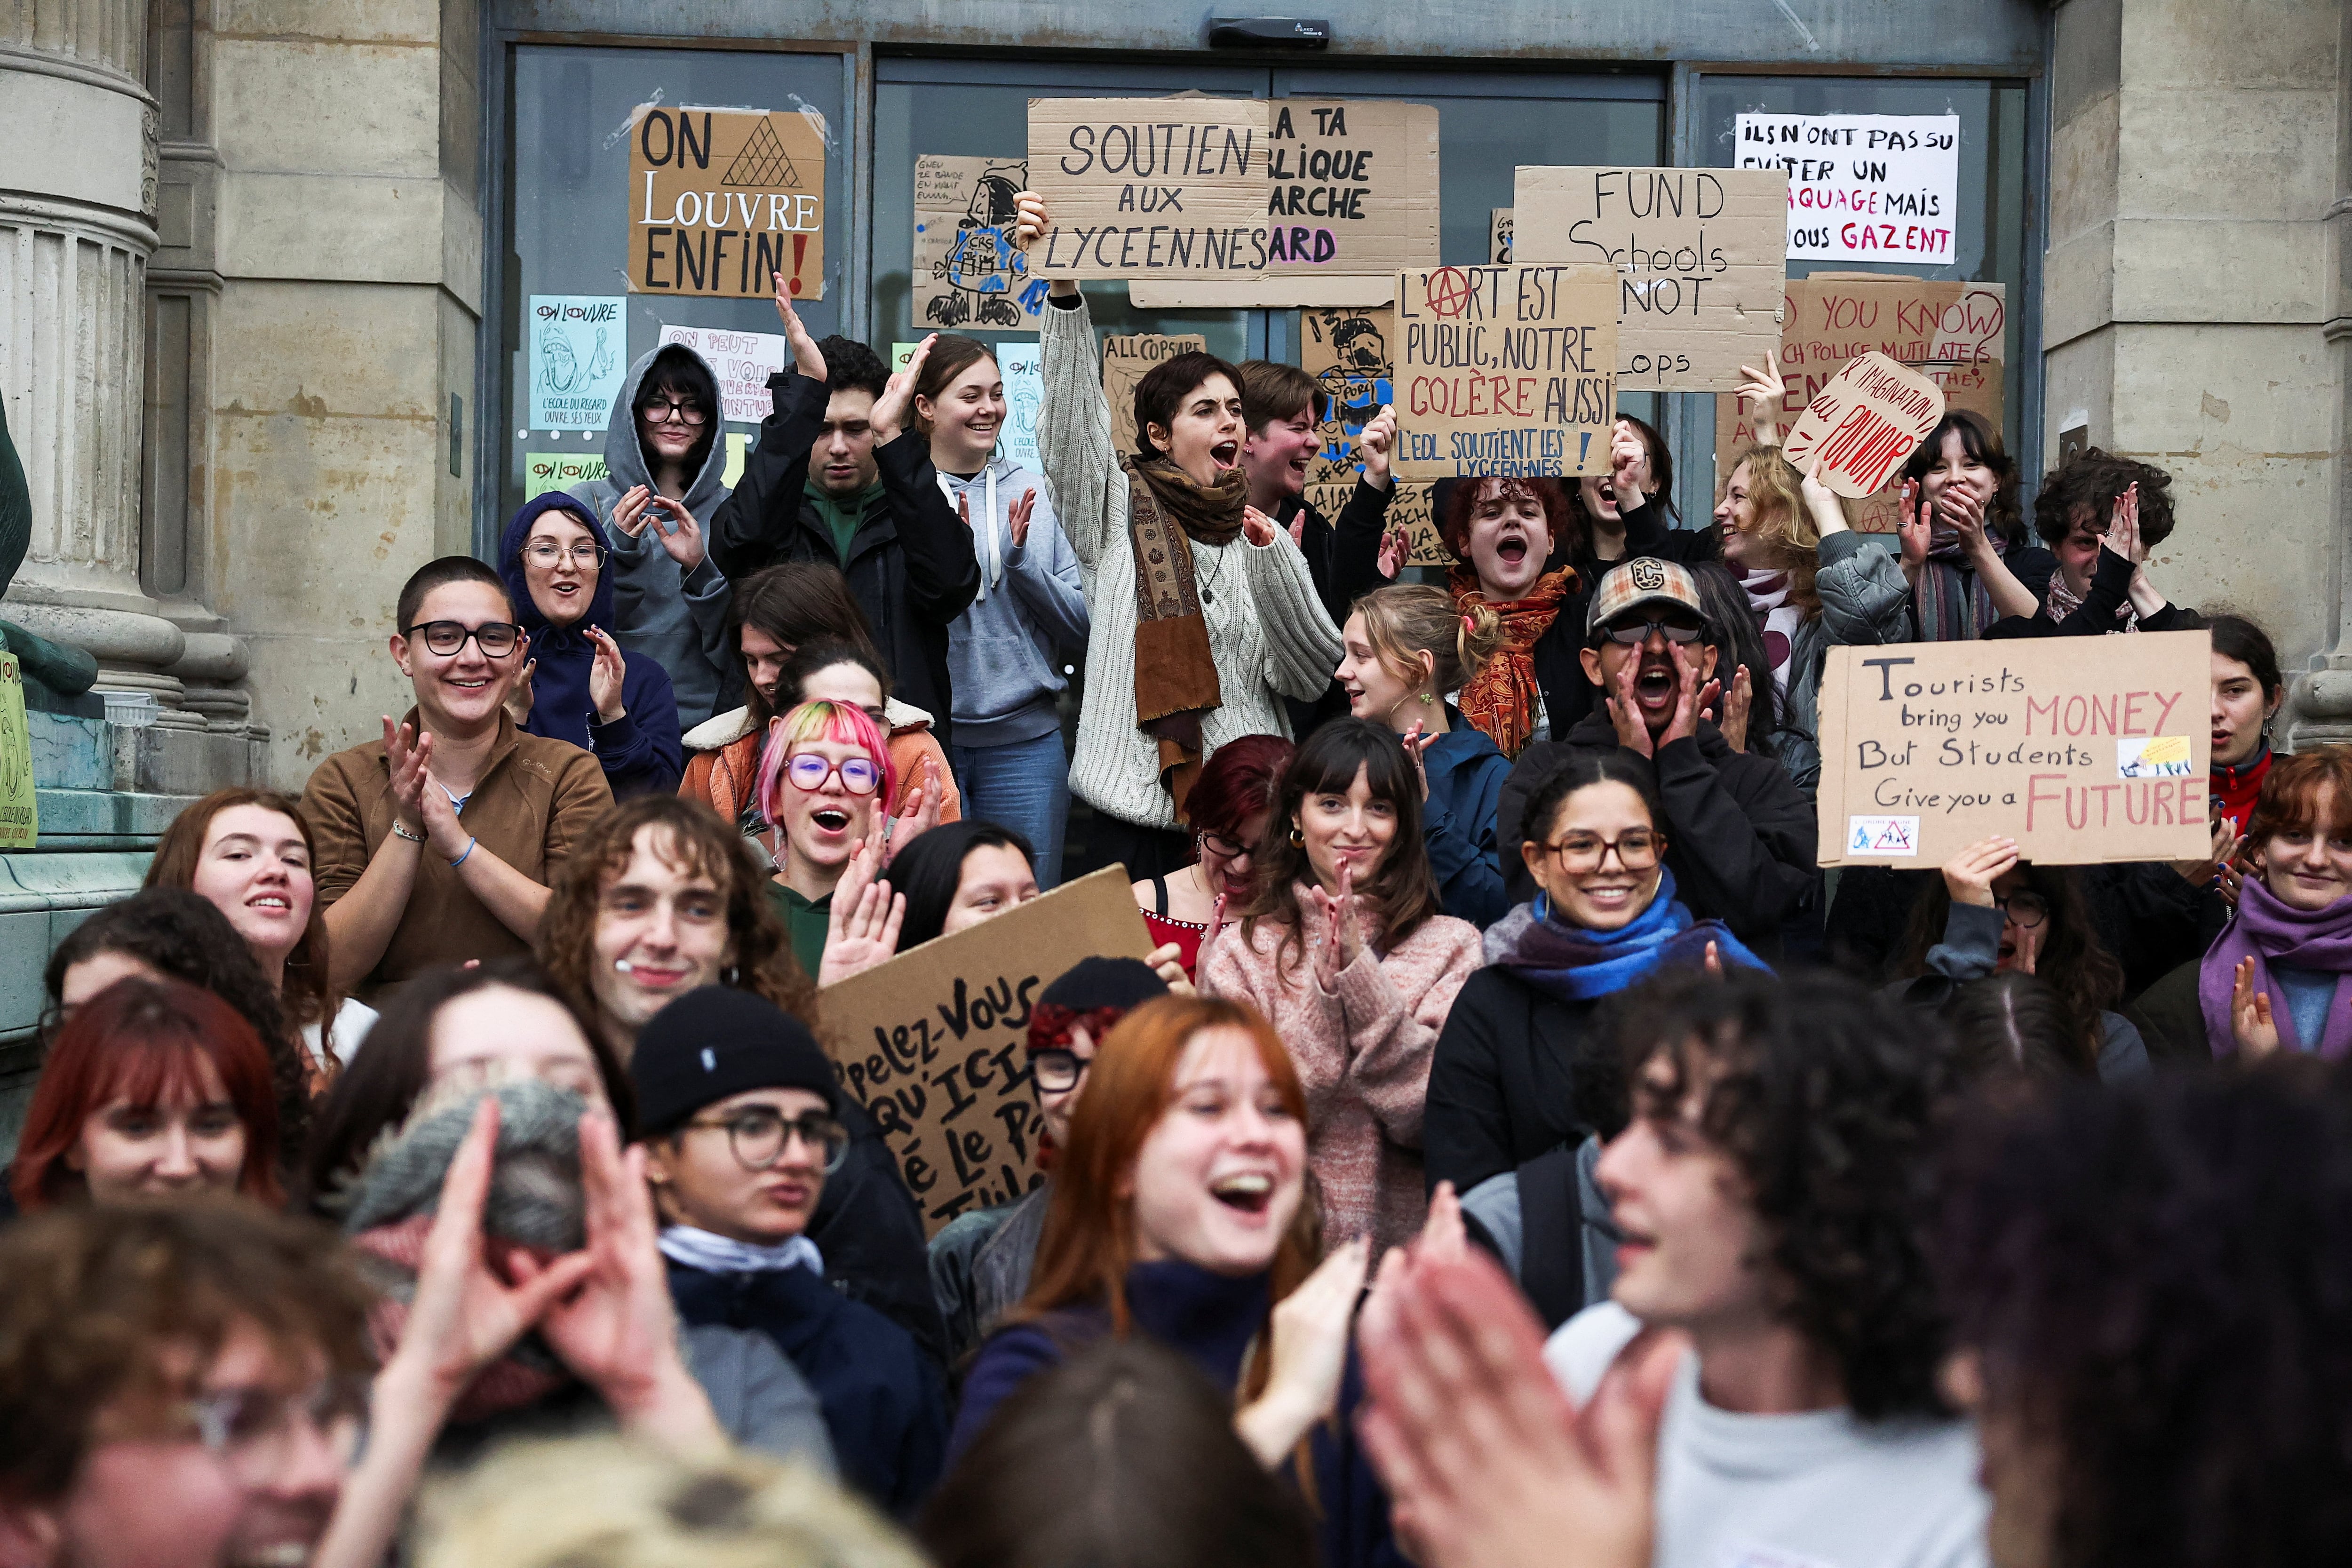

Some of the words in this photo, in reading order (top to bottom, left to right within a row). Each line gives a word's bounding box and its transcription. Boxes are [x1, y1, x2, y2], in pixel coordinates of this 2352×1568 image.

[1311, 107, 1347, 136] TA
[1781, 119, 1858, 145] N'ONT
[1867, 130, 1919, 151] PAS
[1924, 132, 1954, 150] SU
[642, 110, 710, 169] ON
[1061, 124, 1252, 176] SOUTIEN
[1853, 161, 1886, 183] UN
[637, 170, 819, 231] LOUVRE
[1118, 184, 1183, 213] AUX
[1595, 171, 1724, 219] FUND
[969, 236, 994, 249] CRS
[1788, 227, 1829, 247] OUS
[1841, 223, 1951, 253] GAZENT
[1401, 266, 1509, 321] L'ART
[1517, 266, 1568, 321] EST
[1623, 277, 1713, 316] NOT
[537, 303, 560, 321] ON
[562, 303, 618, 323] LOUVRE
[1822, 295, 1878, 331] YOU
[669, 330, 698, 347] ON
[707, 333, 758, 354] PEUT
[1105, 338, 1138, 358] ALL
[1140, 339, 1176, 360] COPS
[1503, 326, 1596, 373] NOTRE
[1617, 355, 1690, 384] ops
[1930, 371, 1985, 389] THEY
[545, 411, 569, 423] OUVRE
[572, 411, 582, 424] SES
[584, 412, 602, 424] YEUX
[570, 398, 579, 409] DU
[580, 398, 607, 411] REGARD
[1810, 395, 1840, 422] au
[1398, 429, 1446, 461] L'EDL
[1540, 429, 1565, 458] LES
[1814, 405, 1914, 494] POUVOIR
[532, 462, 556, 478] ON
[1862, 657, 2025, 700] Tourists
[1902, 703, 1961, 732] bring
[1973, 712, 2008, 729] you
[2026, 691, 2183, 736] MONEY
[1859, 740, 1918, 770] But
[1939, 738, 2093, 766] Students
[1875, 778, 1940, 808] Give
[1947, 793, 1992, 813] you
[2002, 792, 2017, 805] a
[2026, 773, 2206, 832] FUTURE
